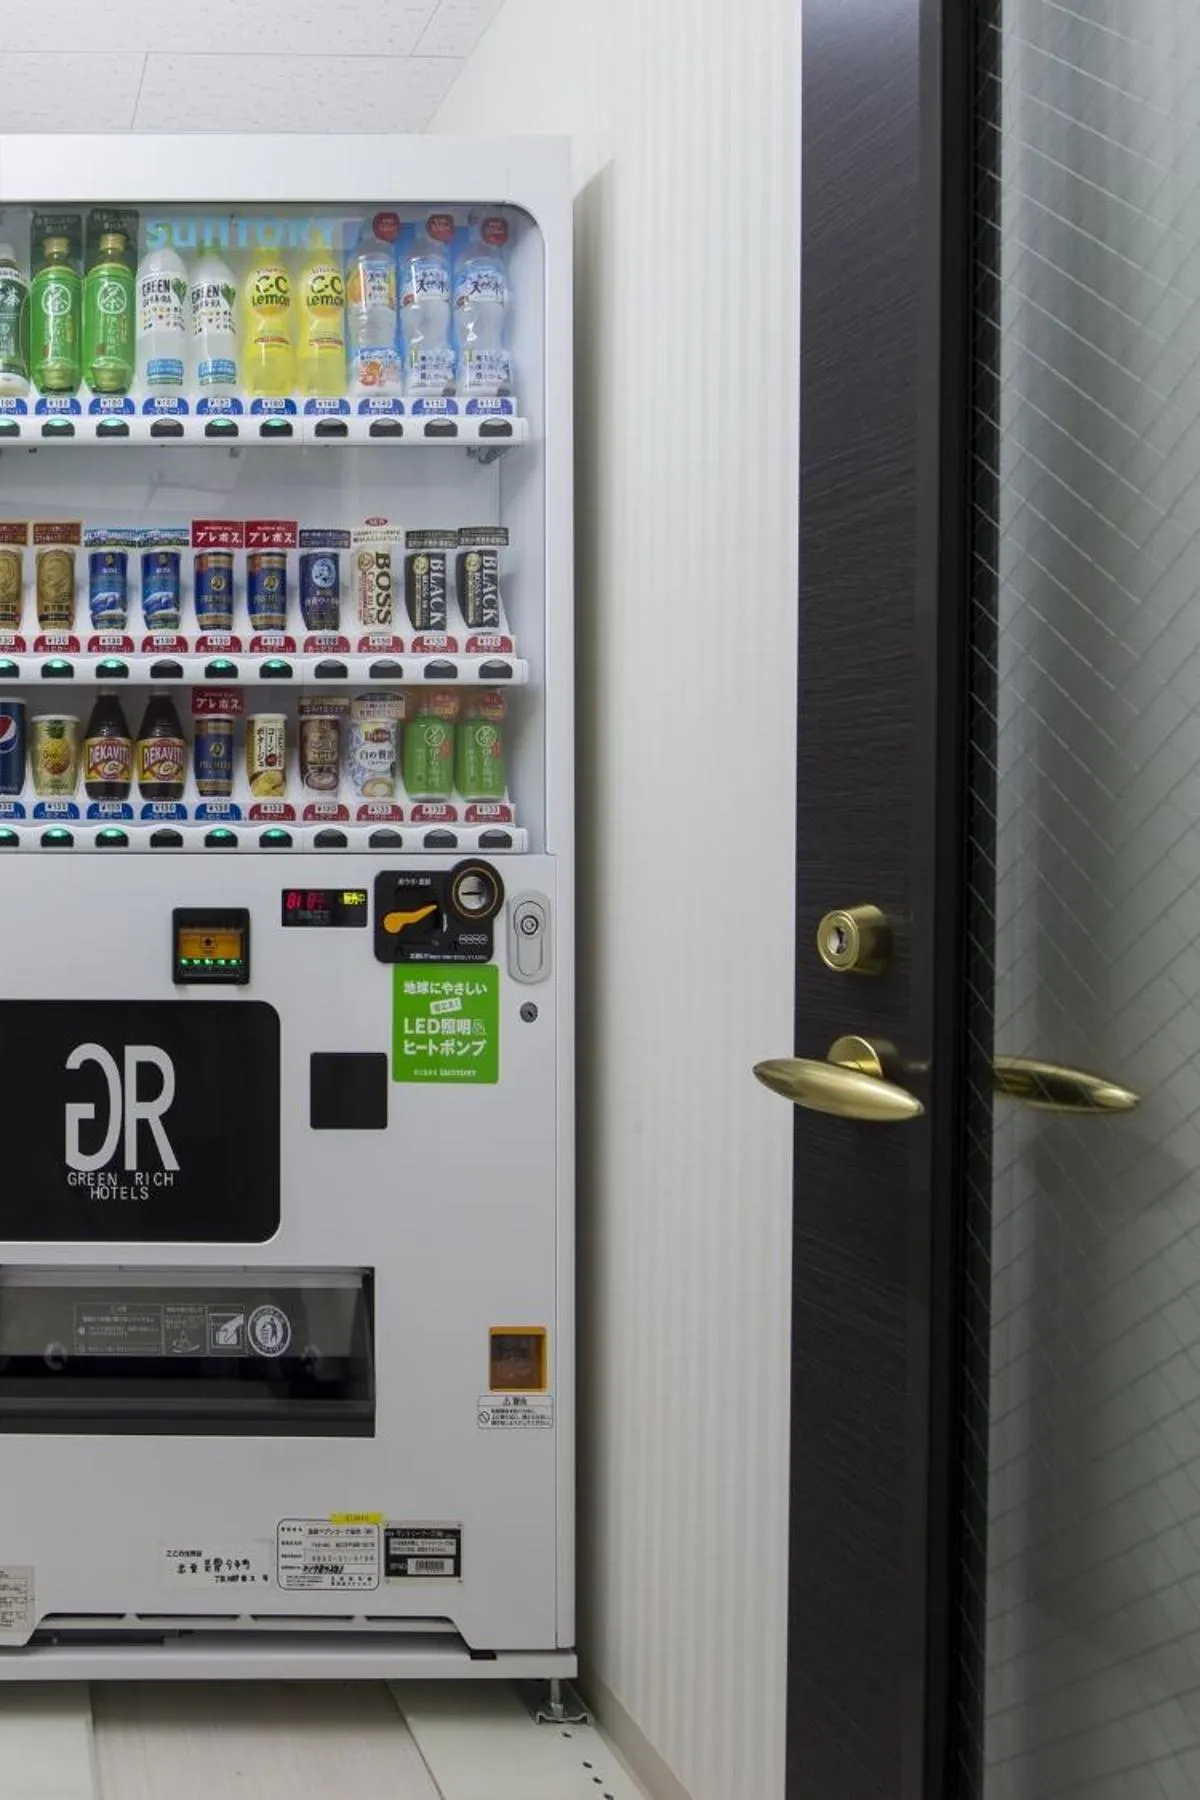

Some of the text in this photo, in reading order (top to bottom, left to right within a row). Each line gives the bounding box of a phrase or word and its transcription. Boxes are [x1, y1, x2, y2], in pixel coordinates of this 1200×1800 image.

[306, 295, 345, 307] Lemo
[375, 552, 392, 625] BOSS
[430, 559, 445, 625] BLACK
[483, 556, 498, 624] BLACK
[403, 981, 487, 996] 地球にやさしい
[403, 1039, 487, 1056] ヒートポンプ
[67, 1172, 174, 1186] GREEN RICH
[90, 1186, 150, 1200] HOTELS
